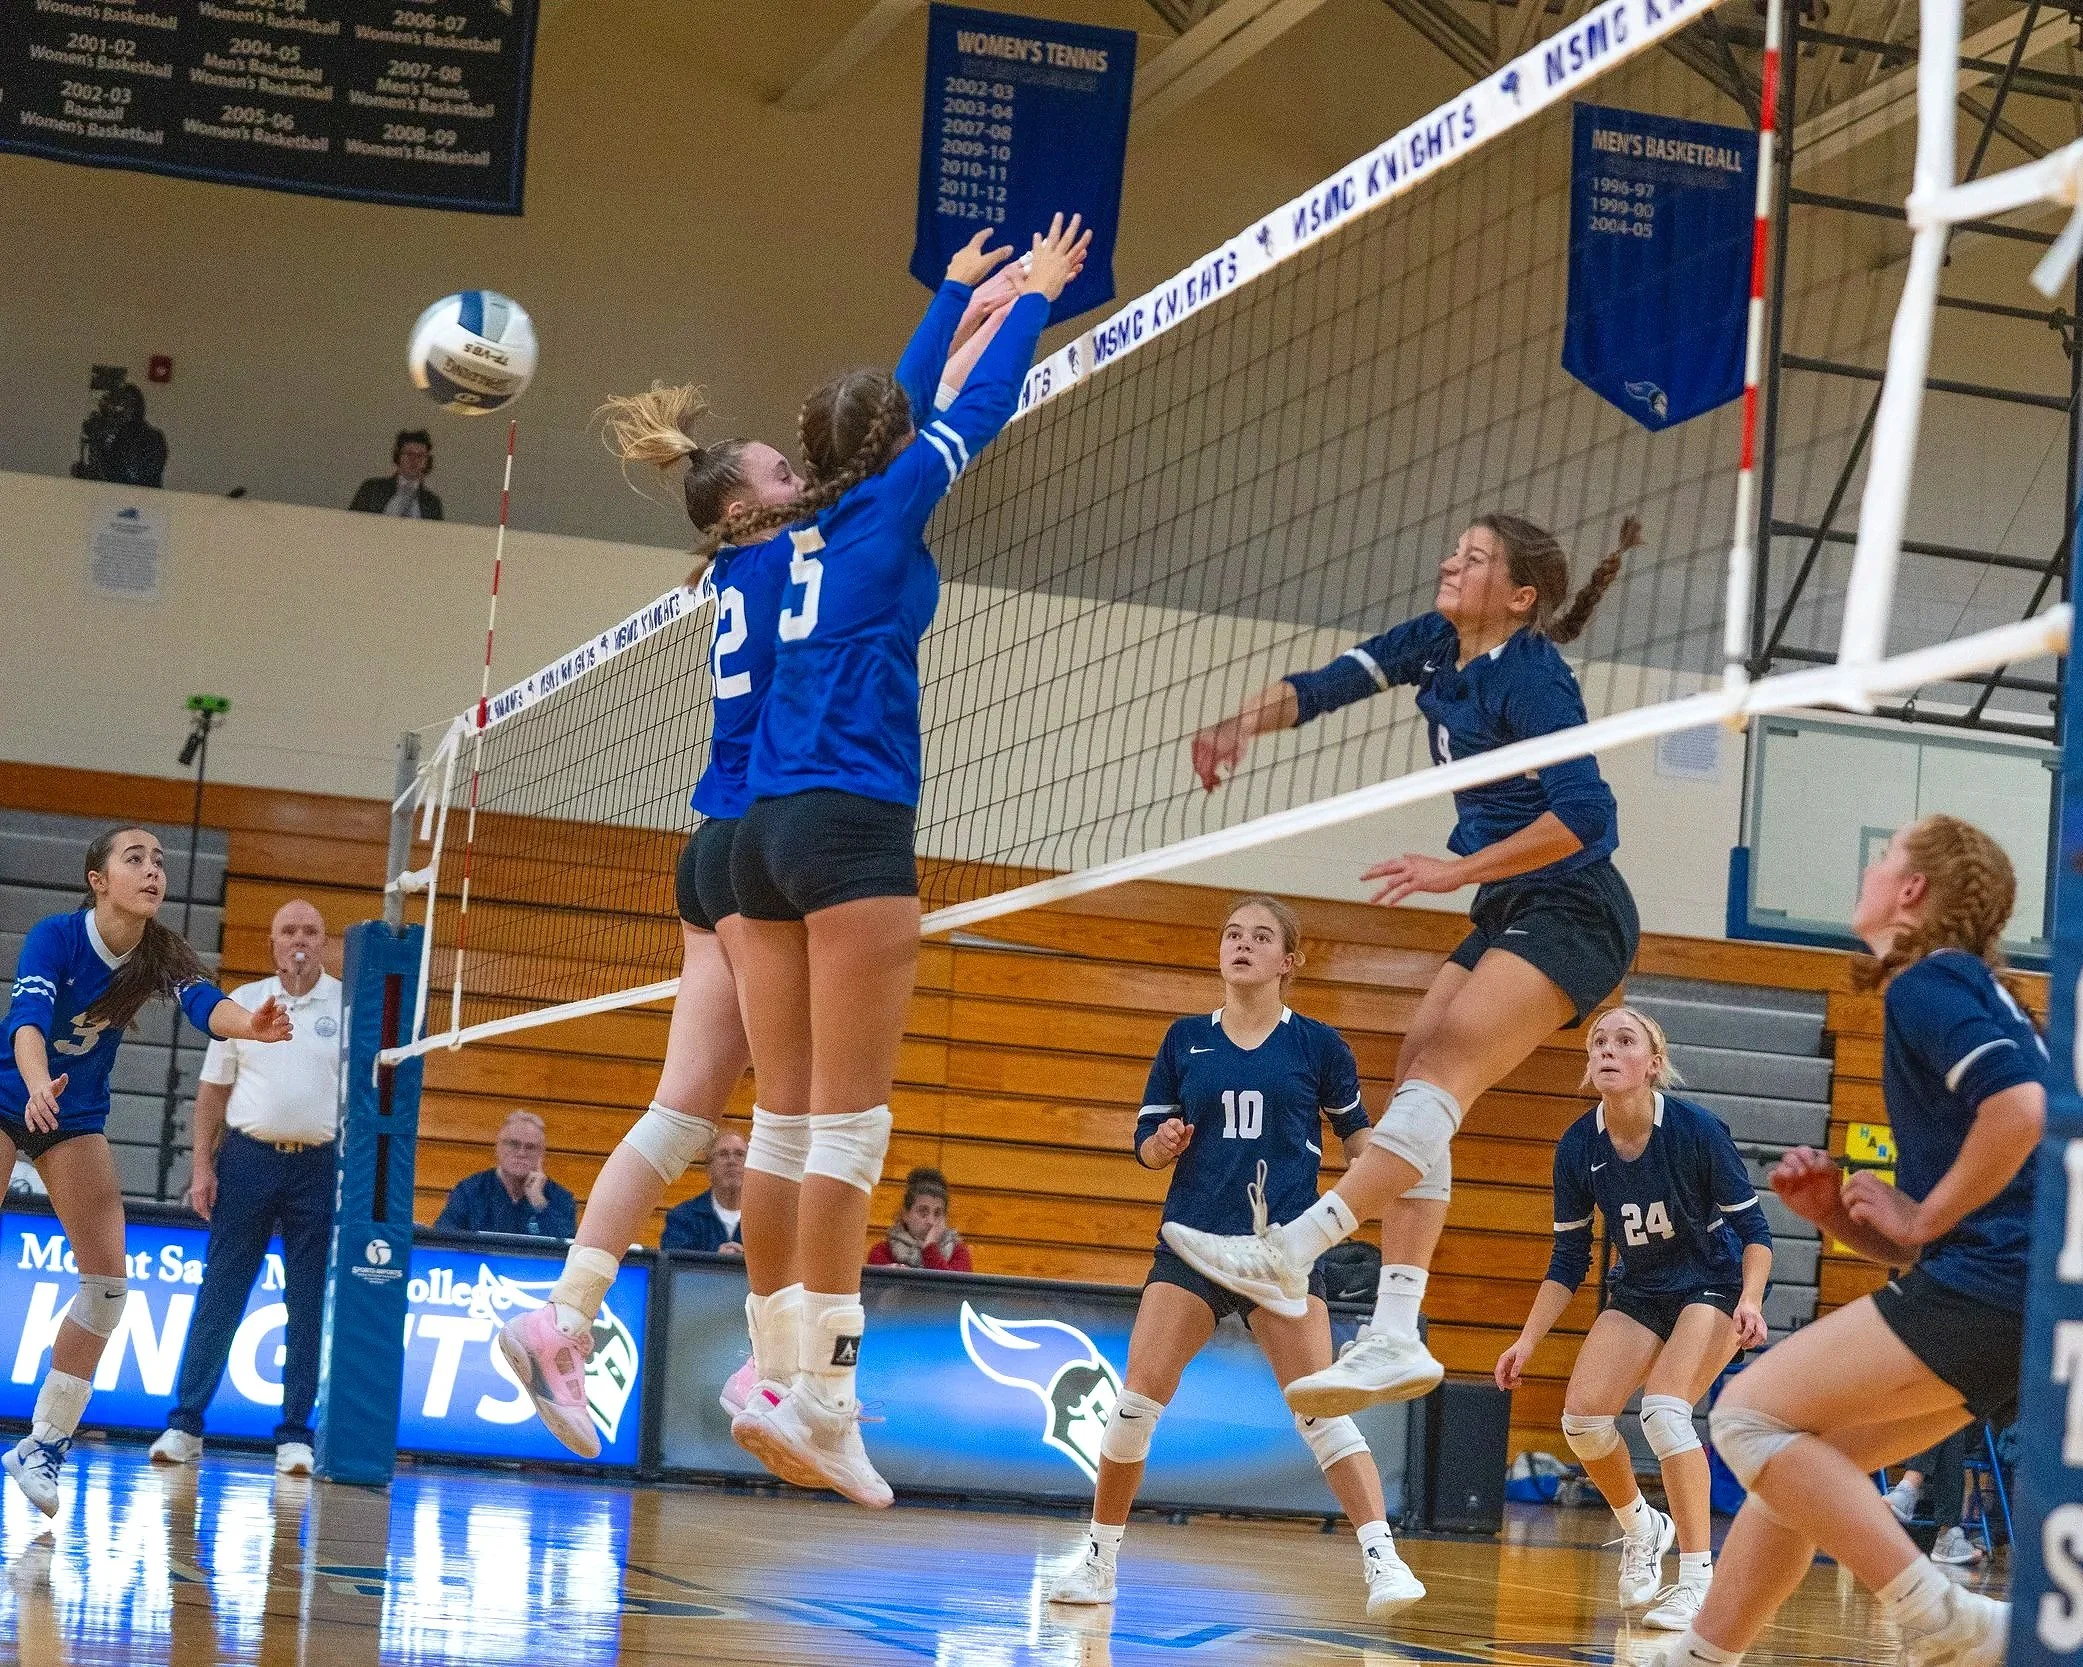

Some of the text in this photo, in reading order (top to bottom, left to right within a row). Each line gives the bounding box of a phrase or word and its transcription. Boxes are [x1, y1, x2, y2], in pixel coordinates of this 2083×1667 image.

[103, 7, 178, 30] Basketball
[266, 12, 340, 35] Basketball
[68, 33, 136, 57] 2001-02
[423, 32, 500, 53] Basketball
[957, 30, 1109, 73] WOMEN'S TENNIS
[97, 55, 173, 79] Basketball
[249, 58, 323, 83] Basketball
[61, 80, 132, 104] 2002-03
[258, 77, 333, 101] Basketball
[945, 76, 1014, 101] 2002-03
[65, 100, 124, 120] Baseball
[418, 97, 495, 118] Basketball
[943, 97, 1013, 121] 2003-04
[87, 122, 164, 145] Basketball
[252, 128, 329, 151] Basketball
[414, 145, 490, 167] Basketball
[1366, 103, 1477, 197] KNIGHTS
[1592, 129, 1742, 173] MEN'S BASKETBALL
[940, 158, 1007, 183] 2010-11
[938, 177, 1007, 204] 2011-12
[937, 196, 1006, 224] 2012-13
[778, 525, 826, 643] 5
[1221, 1090, 1263, 1139] 10
[1620, 1200, 1676, 1246] 24
